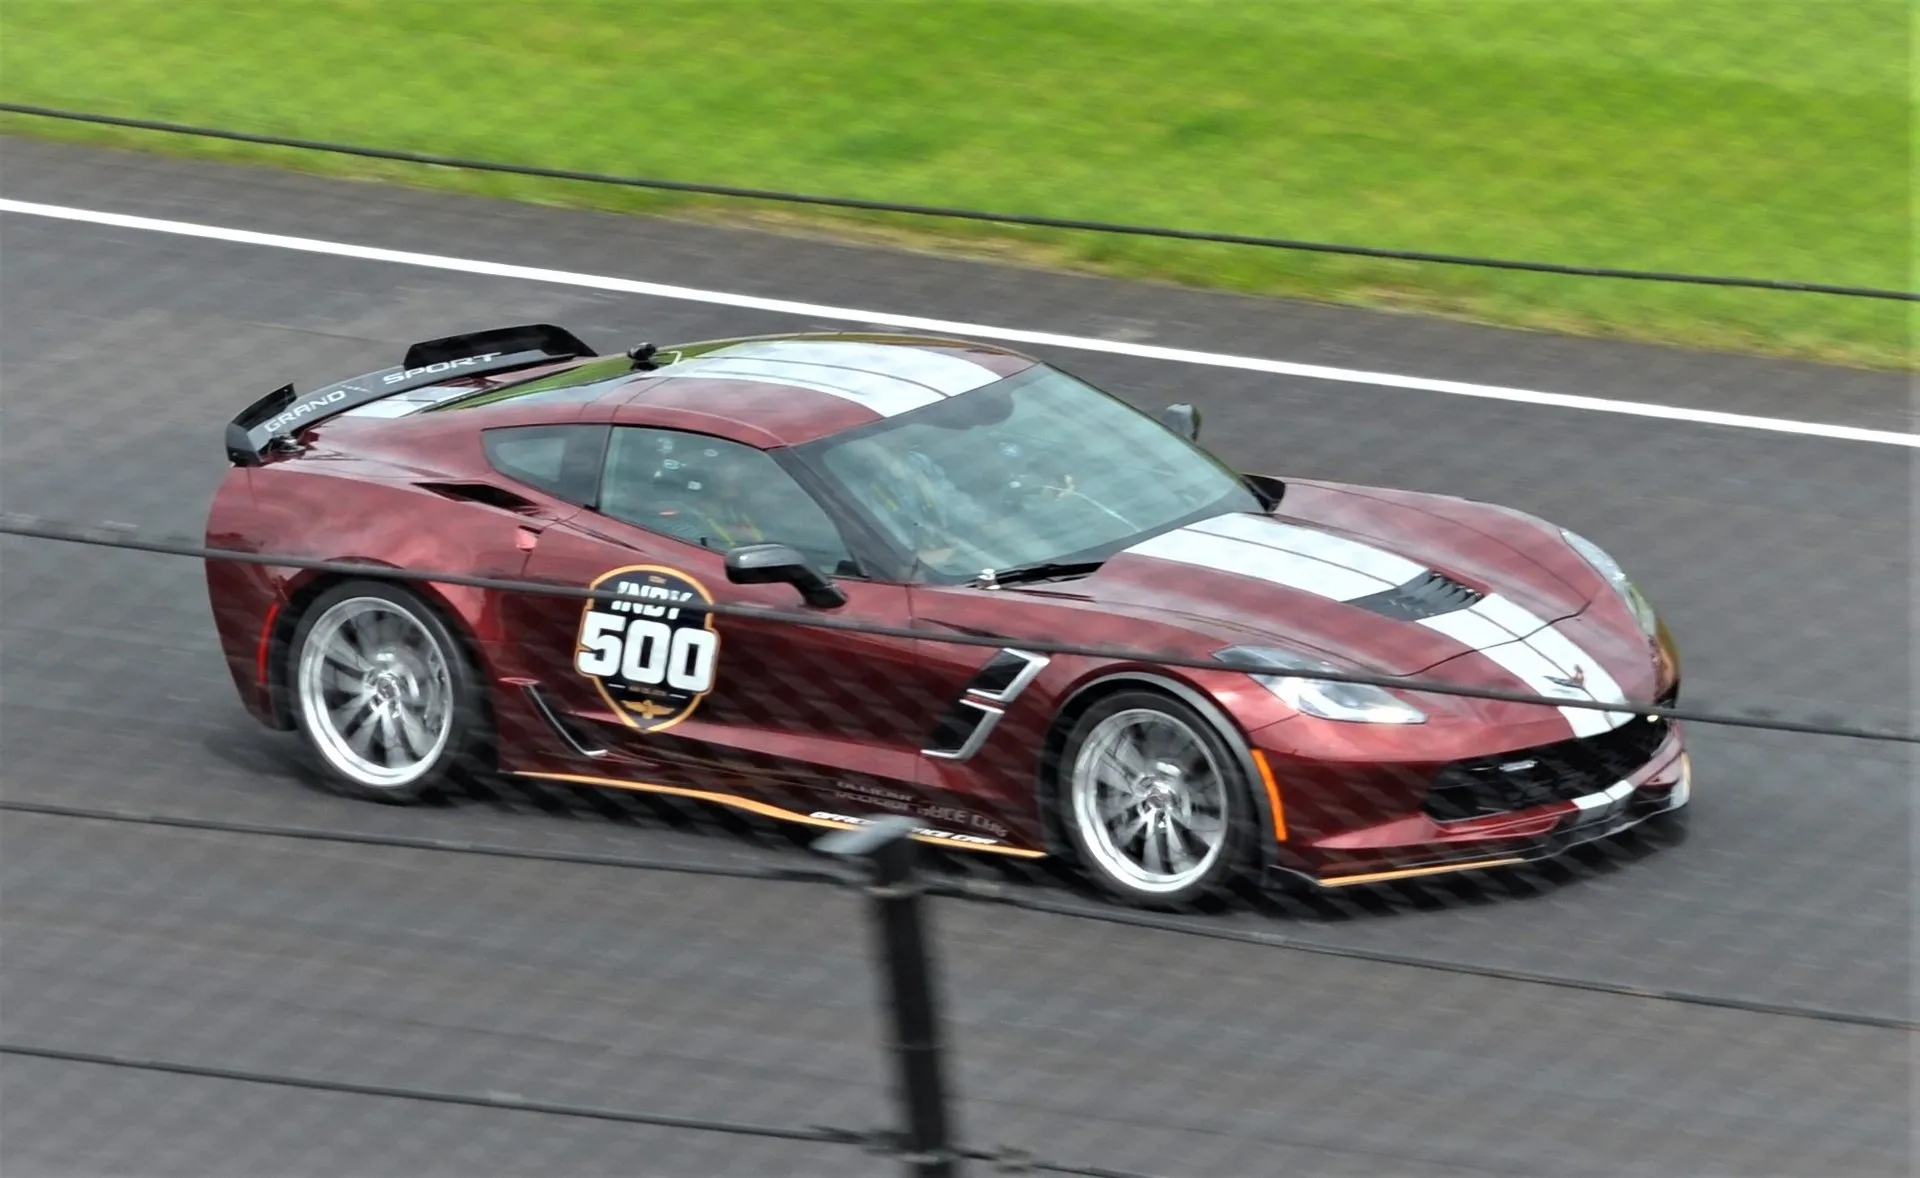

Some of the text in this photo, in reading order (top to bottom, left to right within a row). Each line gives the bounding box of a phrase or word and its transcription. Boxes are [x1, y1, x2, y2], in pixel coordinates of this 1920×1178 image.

[263, 352, 502, 433] GRAND SPORT
[610, 580, 694, 621] INDY
[577, 610, 718, 693] 500
